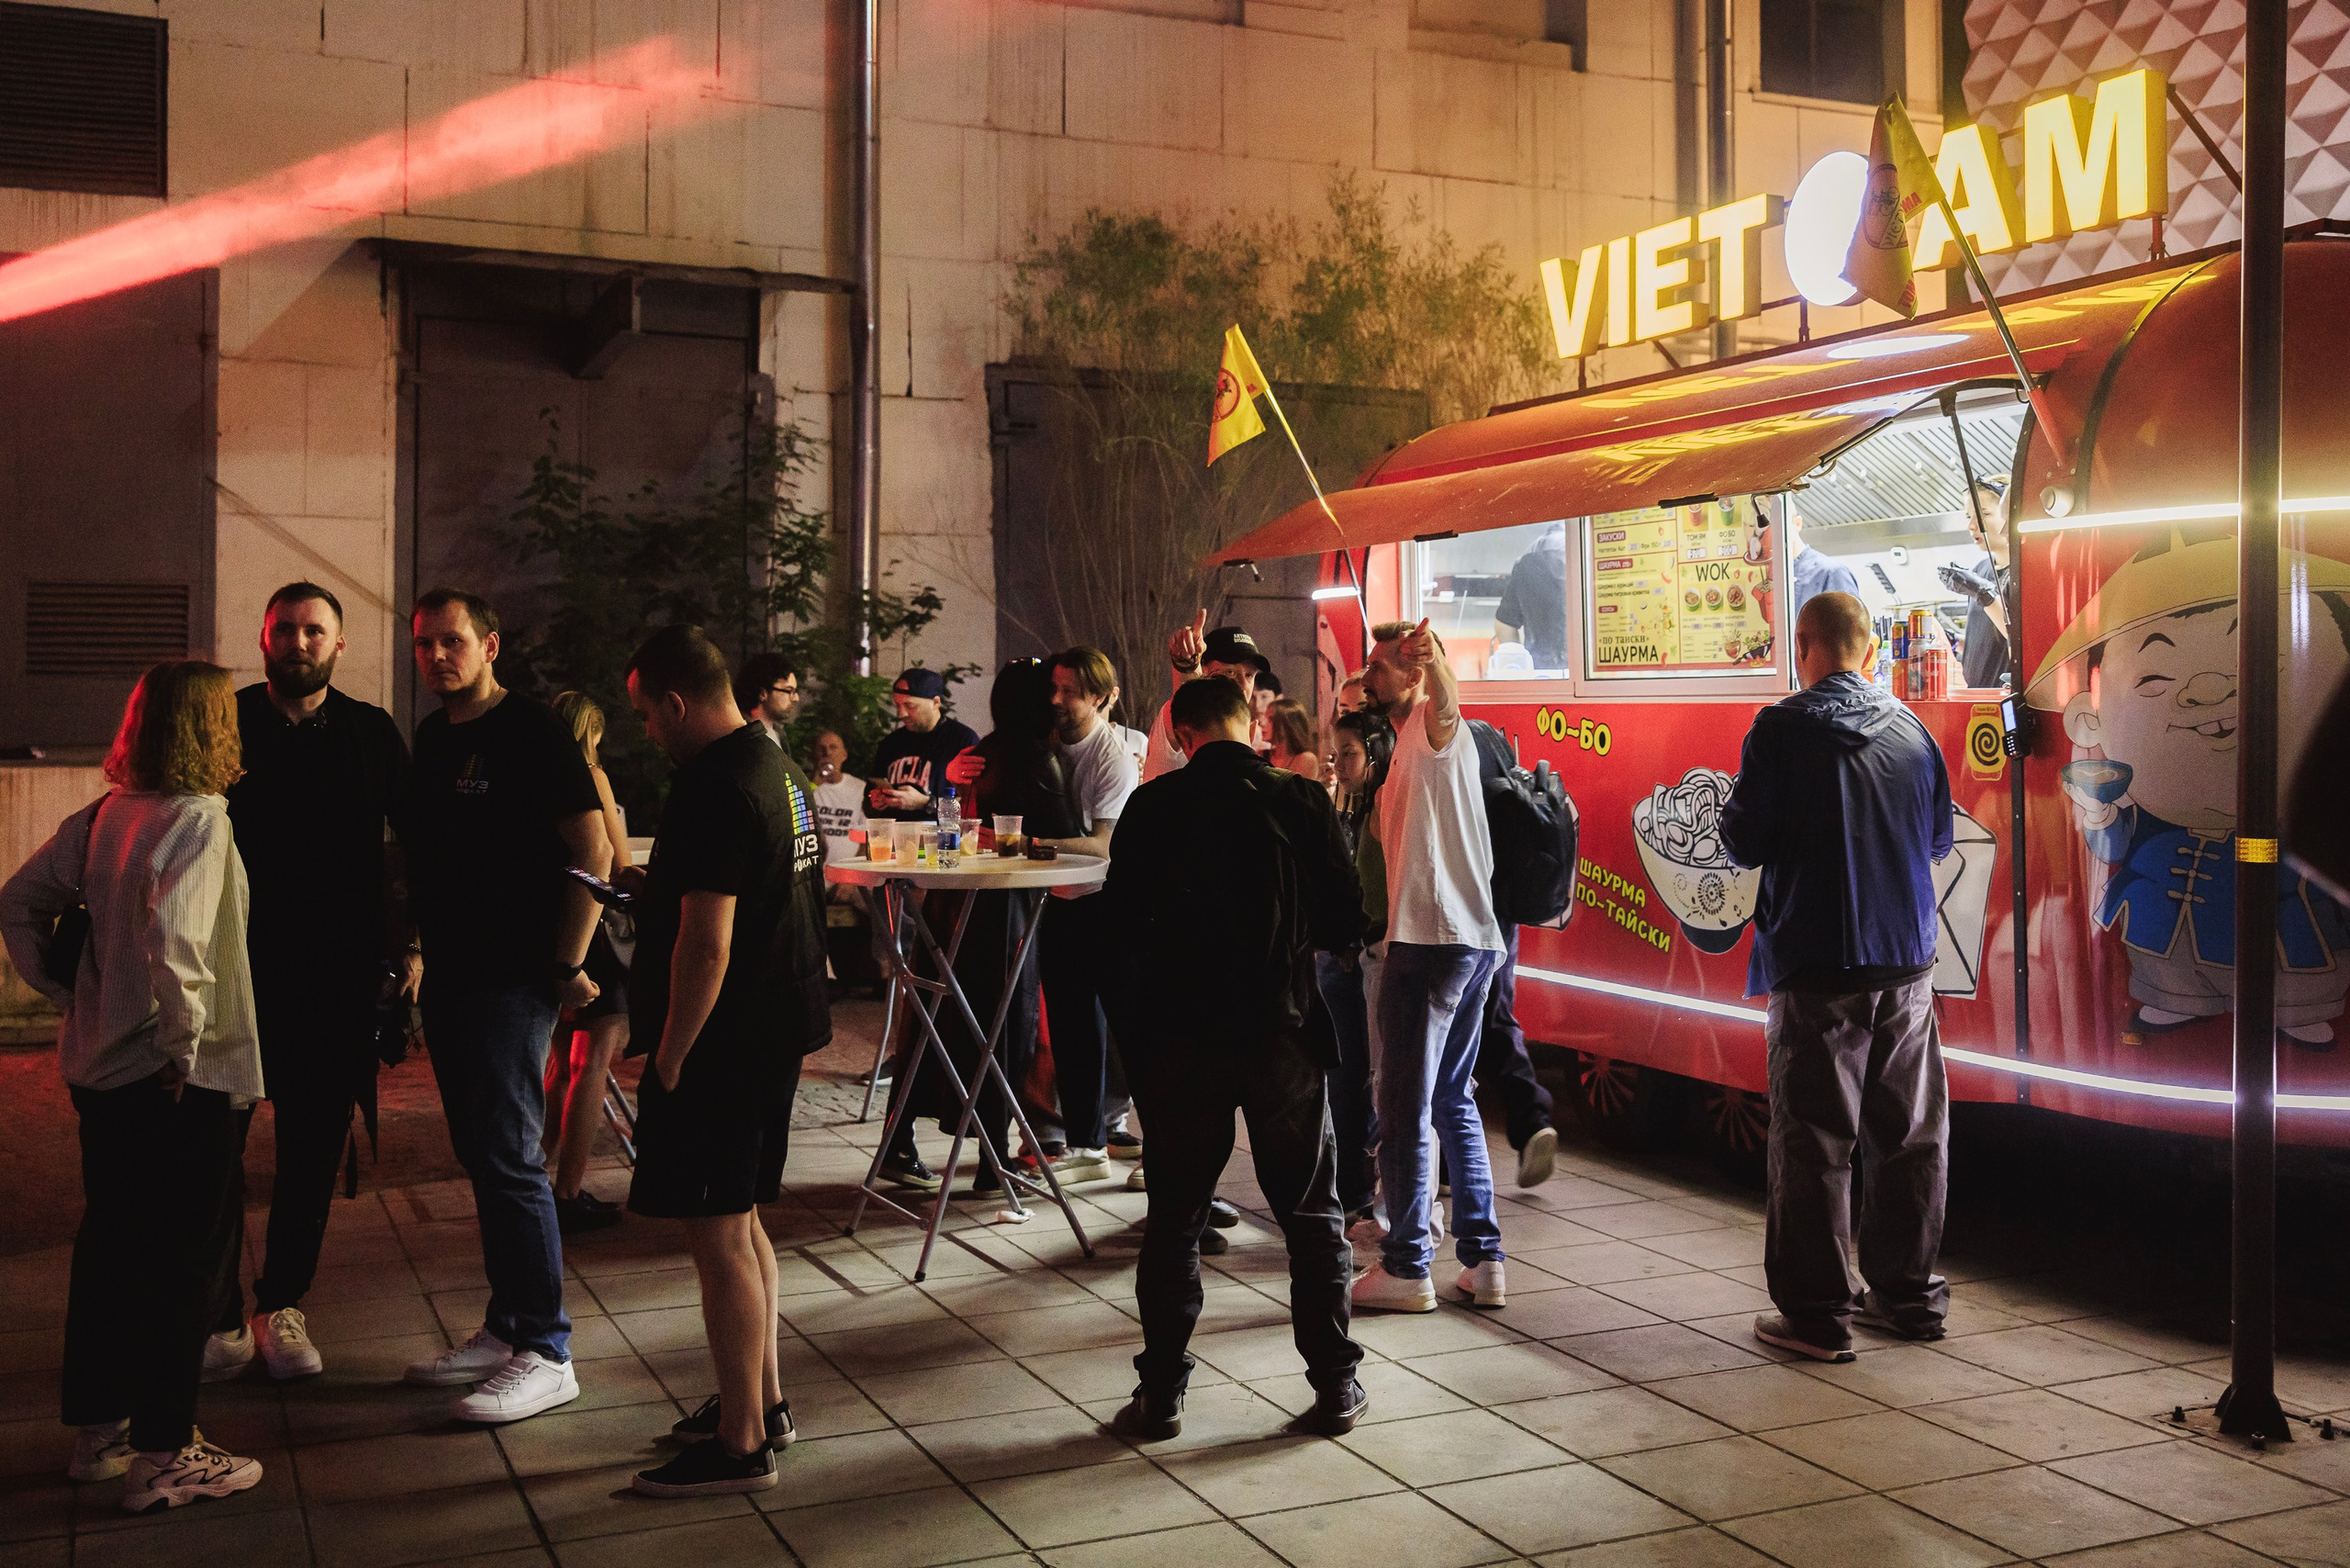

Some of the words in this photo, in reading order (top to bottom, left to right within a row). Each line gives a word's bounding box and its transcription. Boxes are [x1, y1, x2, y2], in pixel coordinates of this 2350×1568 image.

[1695, 562, 1730, 582] WOK
[1598, 644, 1659, 663] ШАУРМА
[1579, 857, 1646, 908] ШАУРМА
[1576, 881, 1671, 953] ПО-ТАЙСКИ
